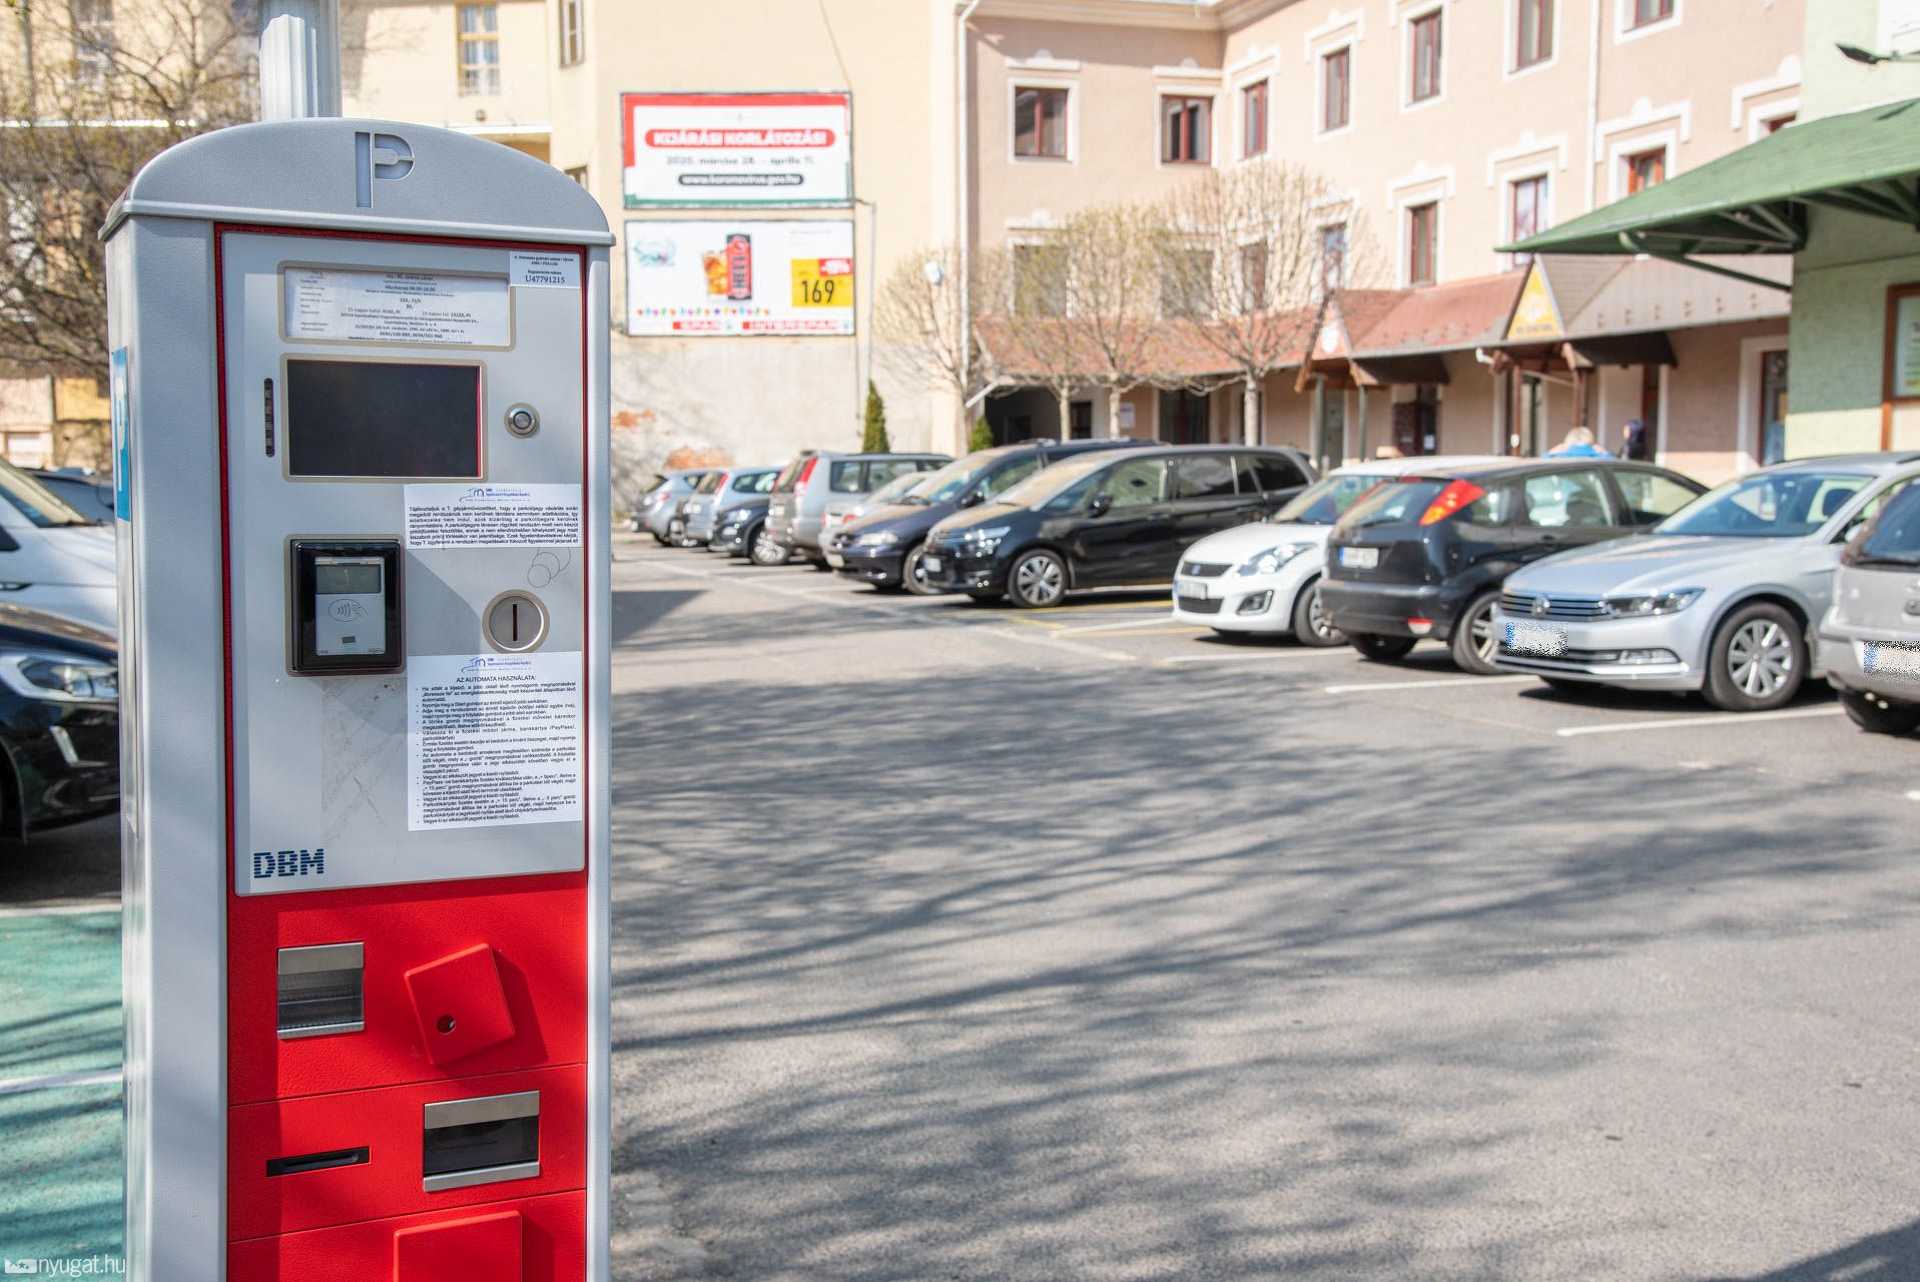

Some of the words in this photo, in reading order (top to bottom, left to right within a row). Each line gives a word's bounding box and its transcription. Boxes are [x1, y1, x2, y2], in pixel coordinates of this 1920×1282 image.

[653, 130, 722, 147] KIJÁRÁSI
[355, 131, 415, 208] P
[525, 274, 566, 285] U47791215
[801, 279, 835, 304] 169
[254, 848, 324, 878] DBM
